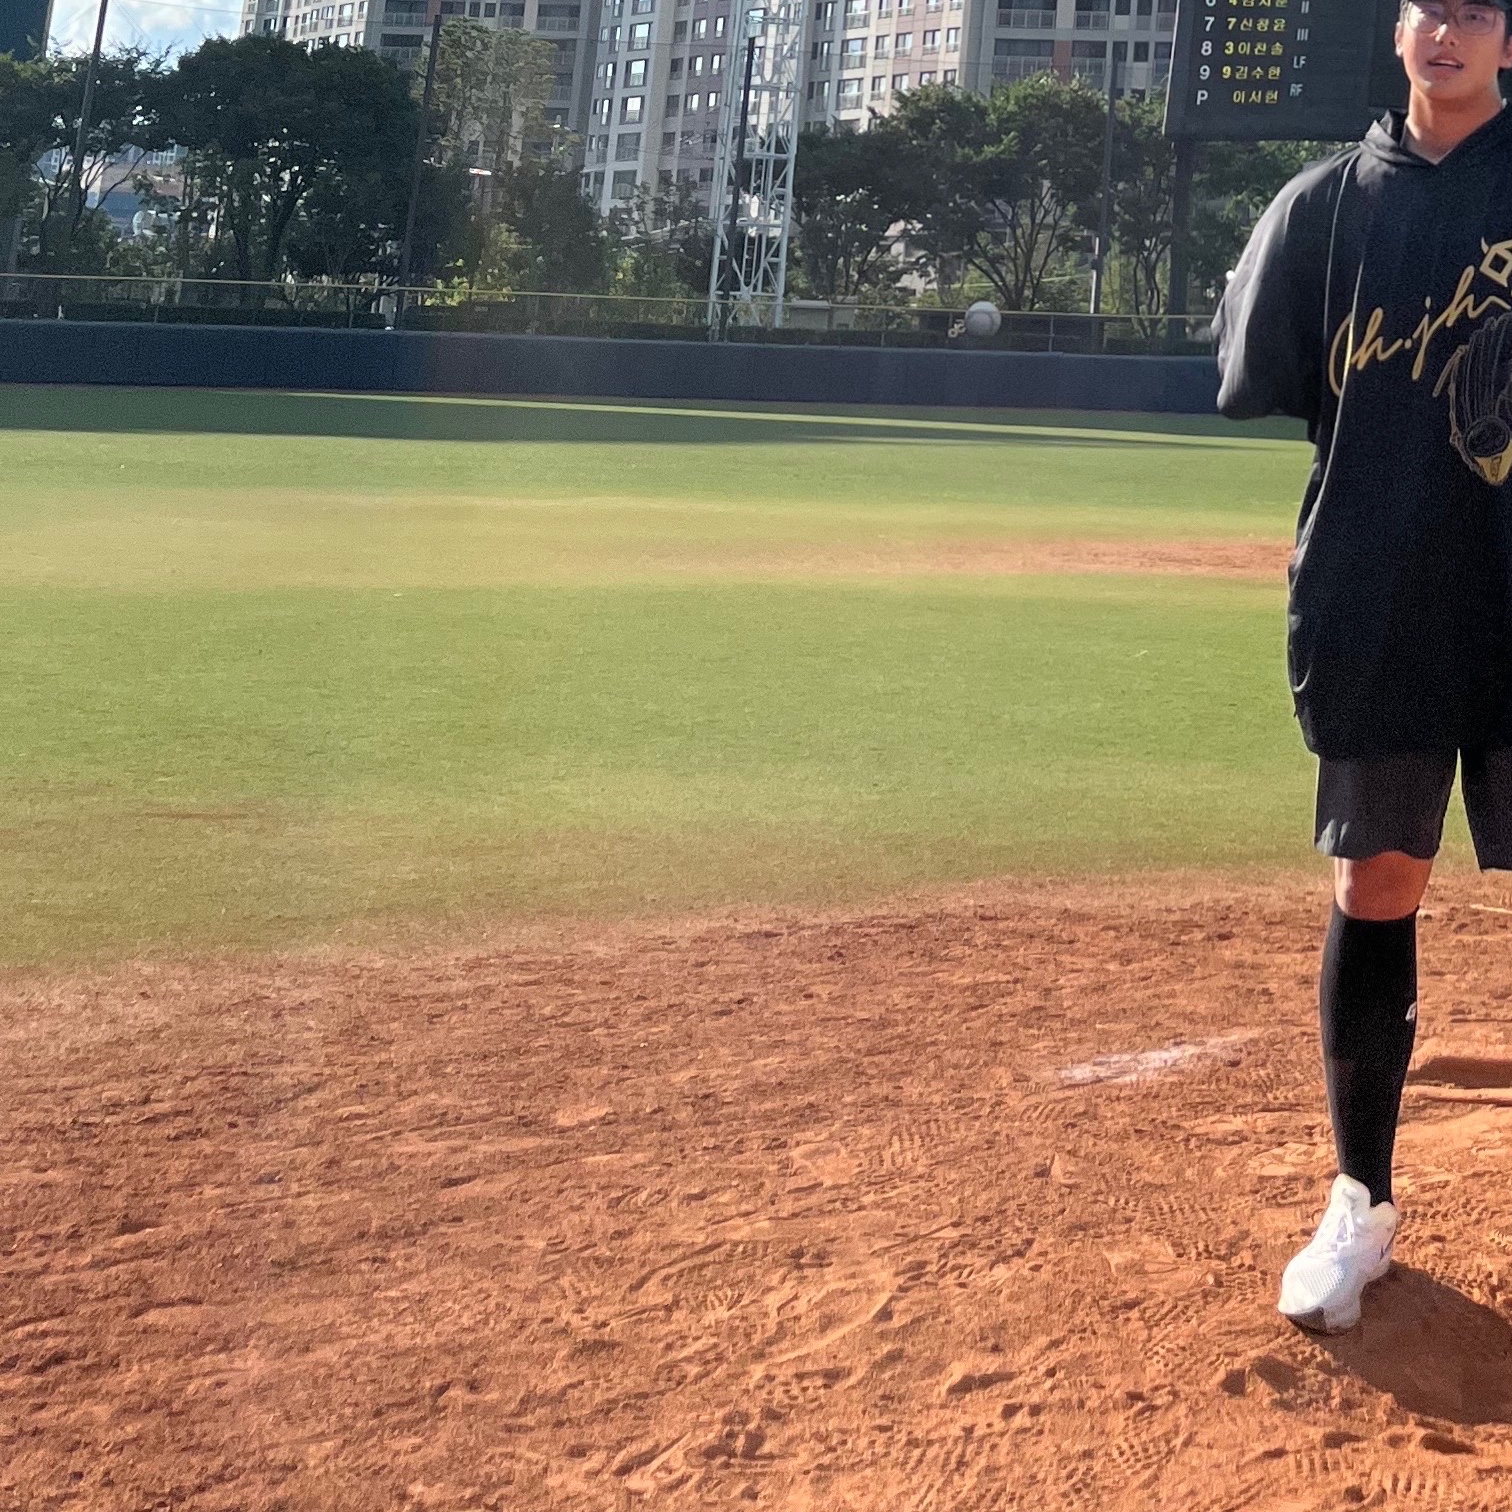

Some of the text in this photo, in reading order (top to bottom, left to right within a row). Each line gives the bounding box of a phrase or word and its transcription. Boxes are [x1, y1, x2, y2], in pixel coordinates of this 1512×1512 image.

[1205, 17, 1214, 31] 7
[1201, 41, 1212, 55] 8
[1294, 56, 1306, 68] LF
[1200, 65, 1210, 80] 9
[1197, 90, 1208, 105] P
